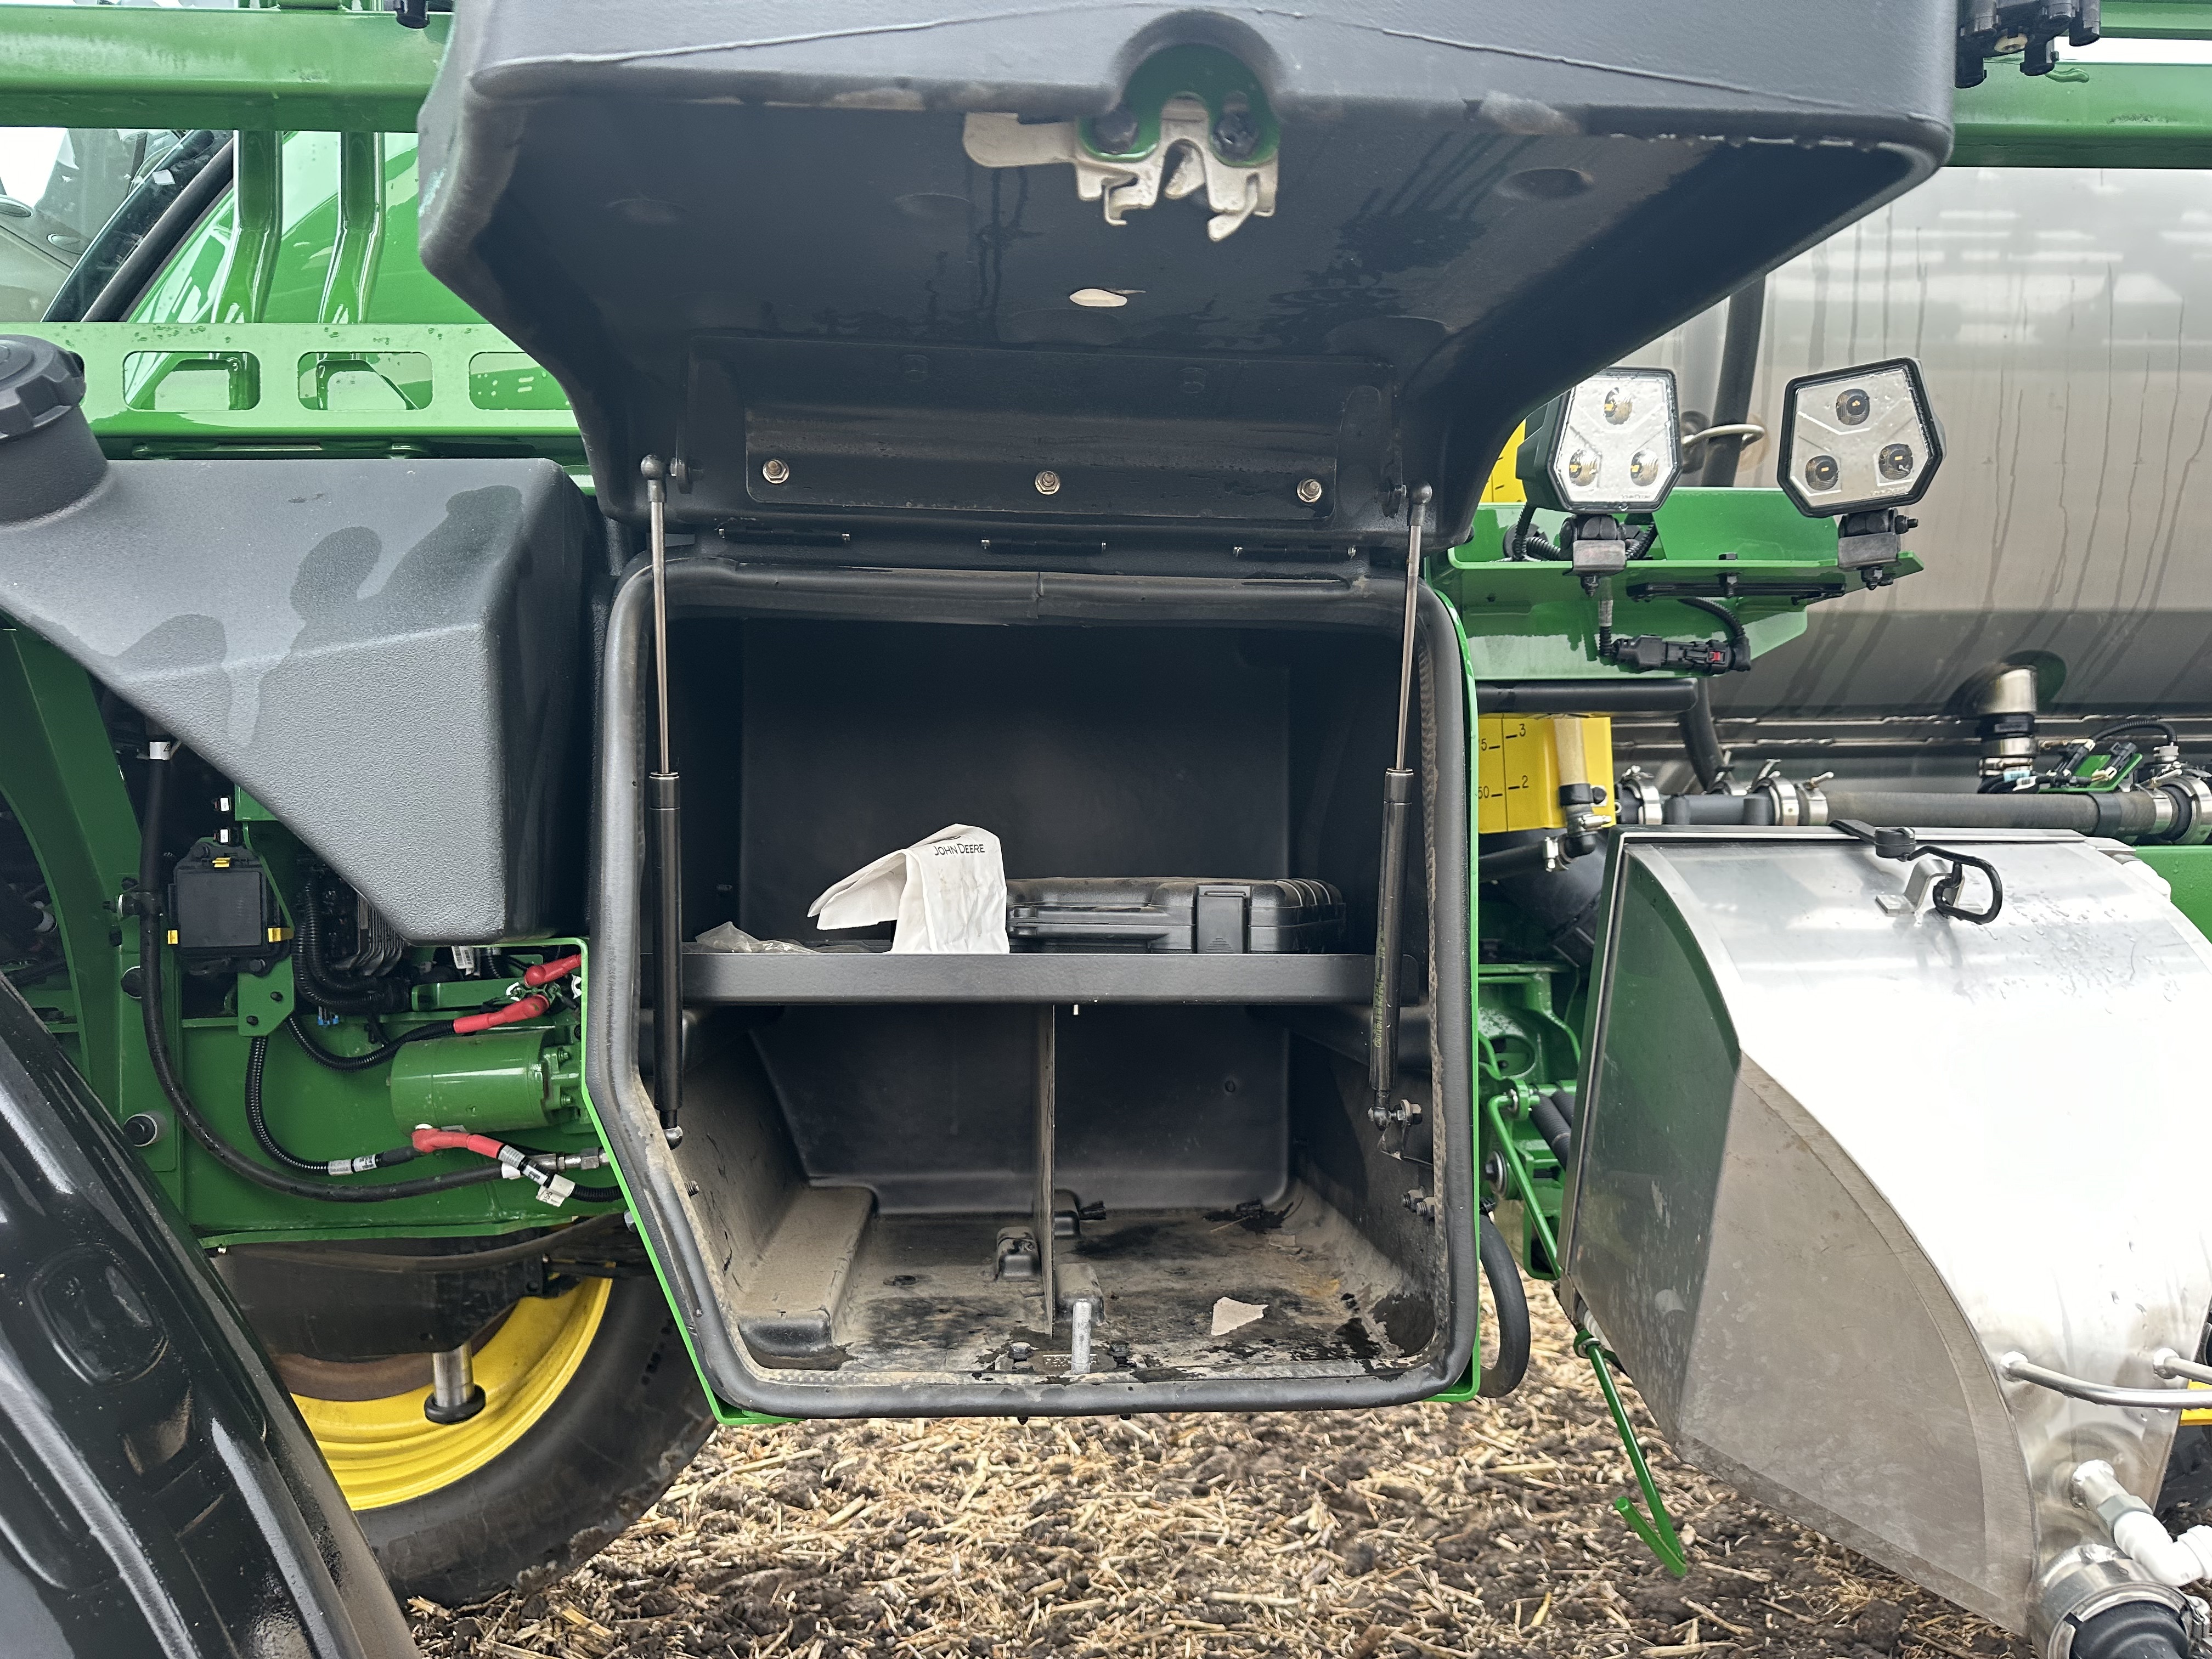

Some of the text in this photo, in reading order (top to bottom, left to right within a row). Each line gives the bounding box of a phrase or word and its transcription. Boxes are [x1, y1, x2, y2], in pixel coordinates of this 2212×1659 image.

[1519, 723, 1526, 737] 3
[1479, 738, 1487, 751] 5
[1522, 775, 1529, 788] 2
[933, 843, 985, 856] JOHN DEERE
